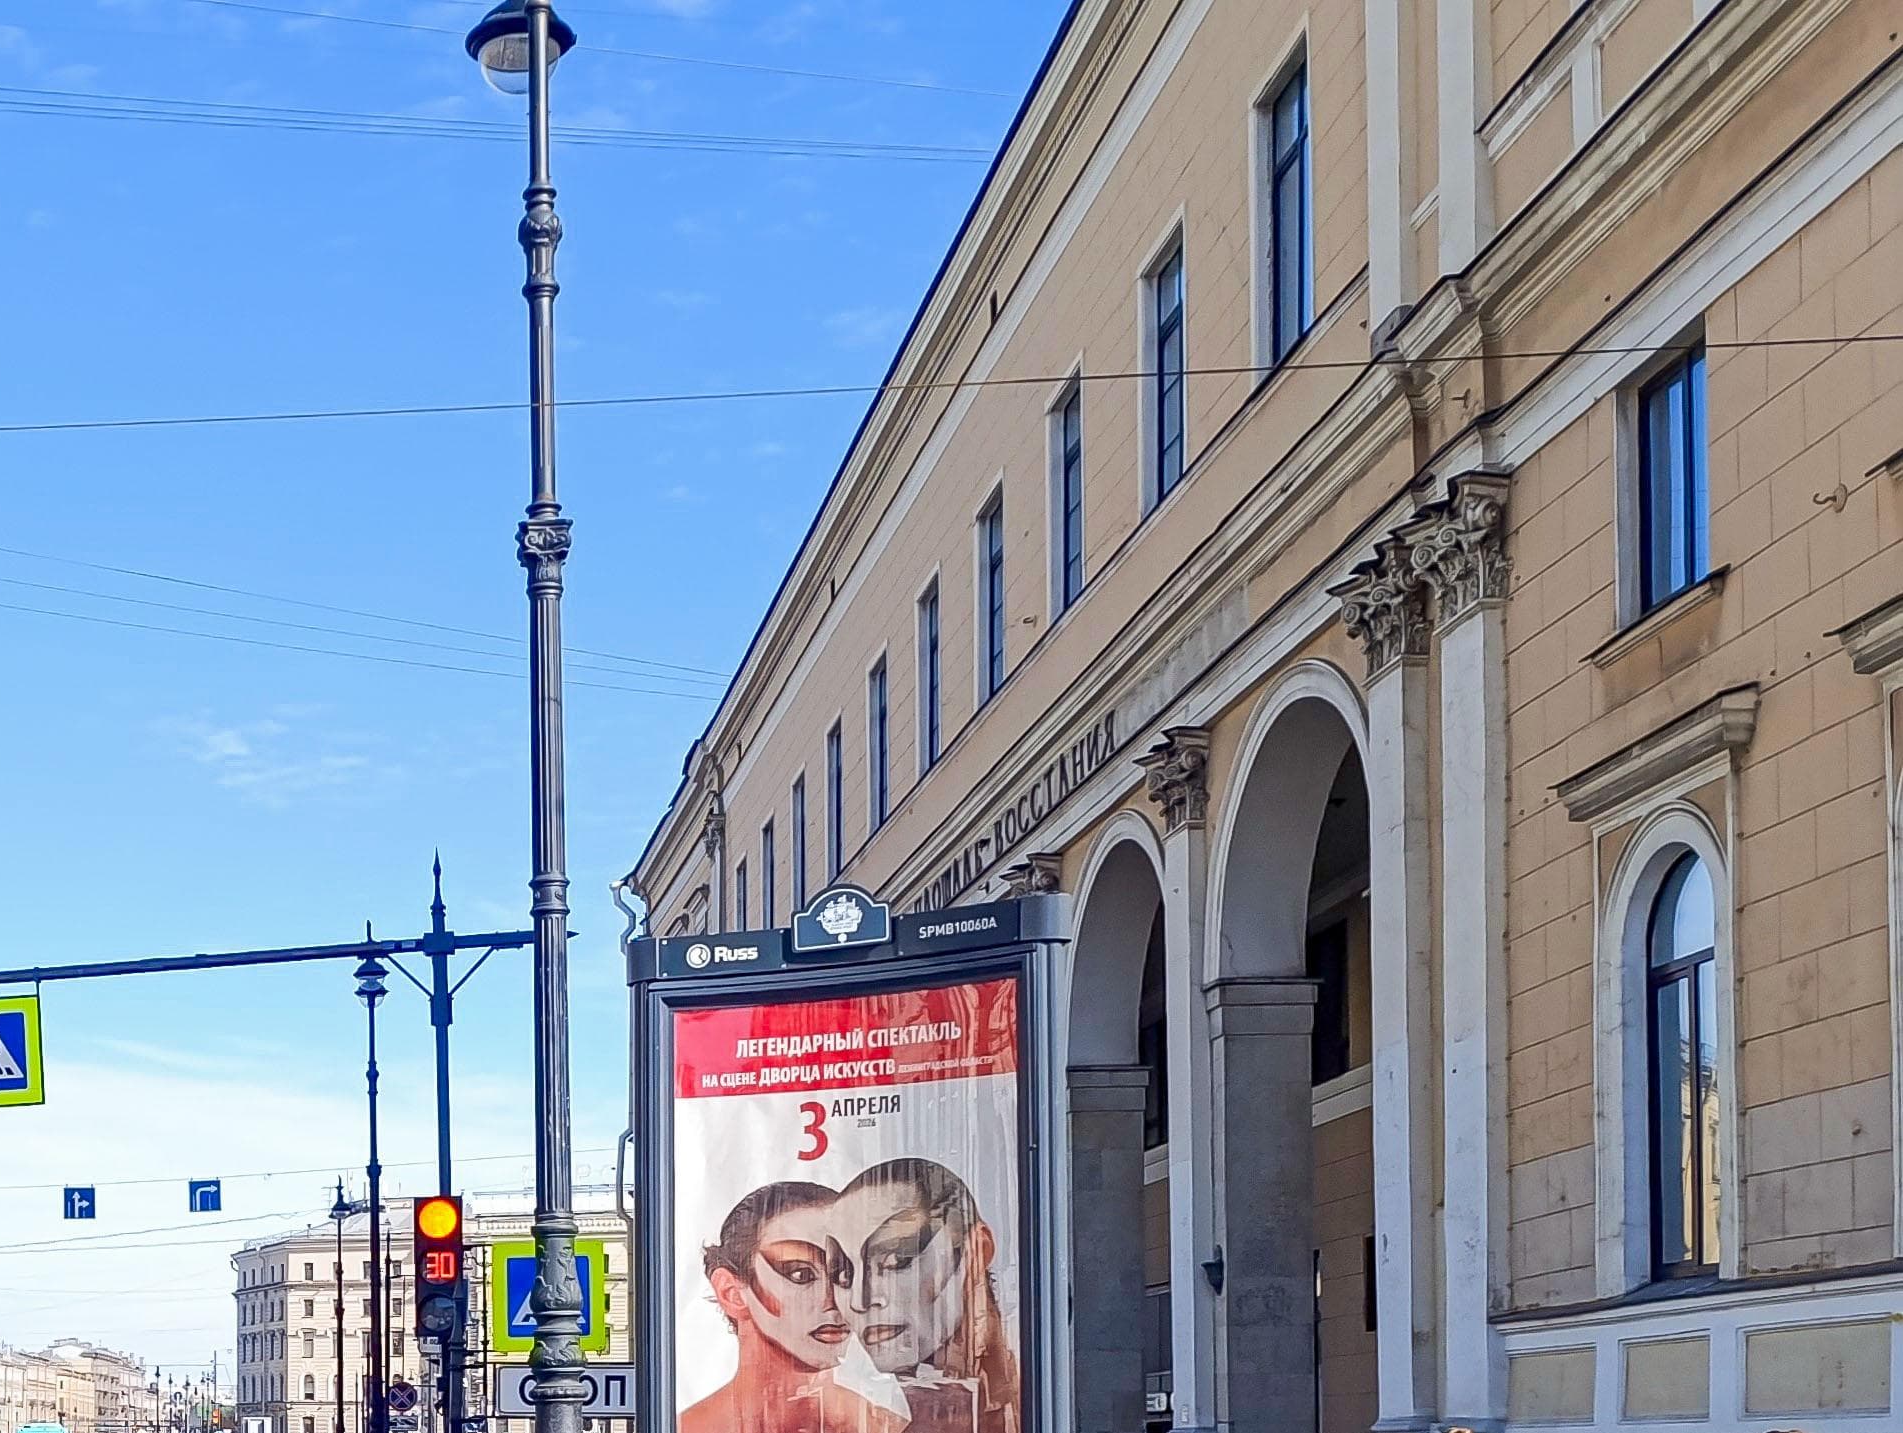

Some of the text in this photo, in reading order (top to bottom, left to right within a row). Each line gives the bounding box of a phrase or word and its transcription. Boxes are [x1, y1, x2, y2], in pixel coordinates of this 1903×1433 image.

[993, 709, 1116, 858] ВОССТАНИЯ
[919, 917, 998, 939] SPMB10060A
[714, 946, 758, 962] Russ
[735, 1022, 962, 1058] ЛЕГЕНДАРНЫЙ СПЕКТАКЛЬ
[702, 1073, 718, 1088] НА
[719, 1071, 757, 1088] СЦЕНЕ
[758, 1065, 820, 1087] ДВОРЦА
[823, 1059, 896, 1080] ИСКУССТВ
[797, 1094, 901, 1161] 3 АПРЕЛЯ
[426, 1252, 455, 1279] 30
[519, 1375, 626, 1406] СОП
